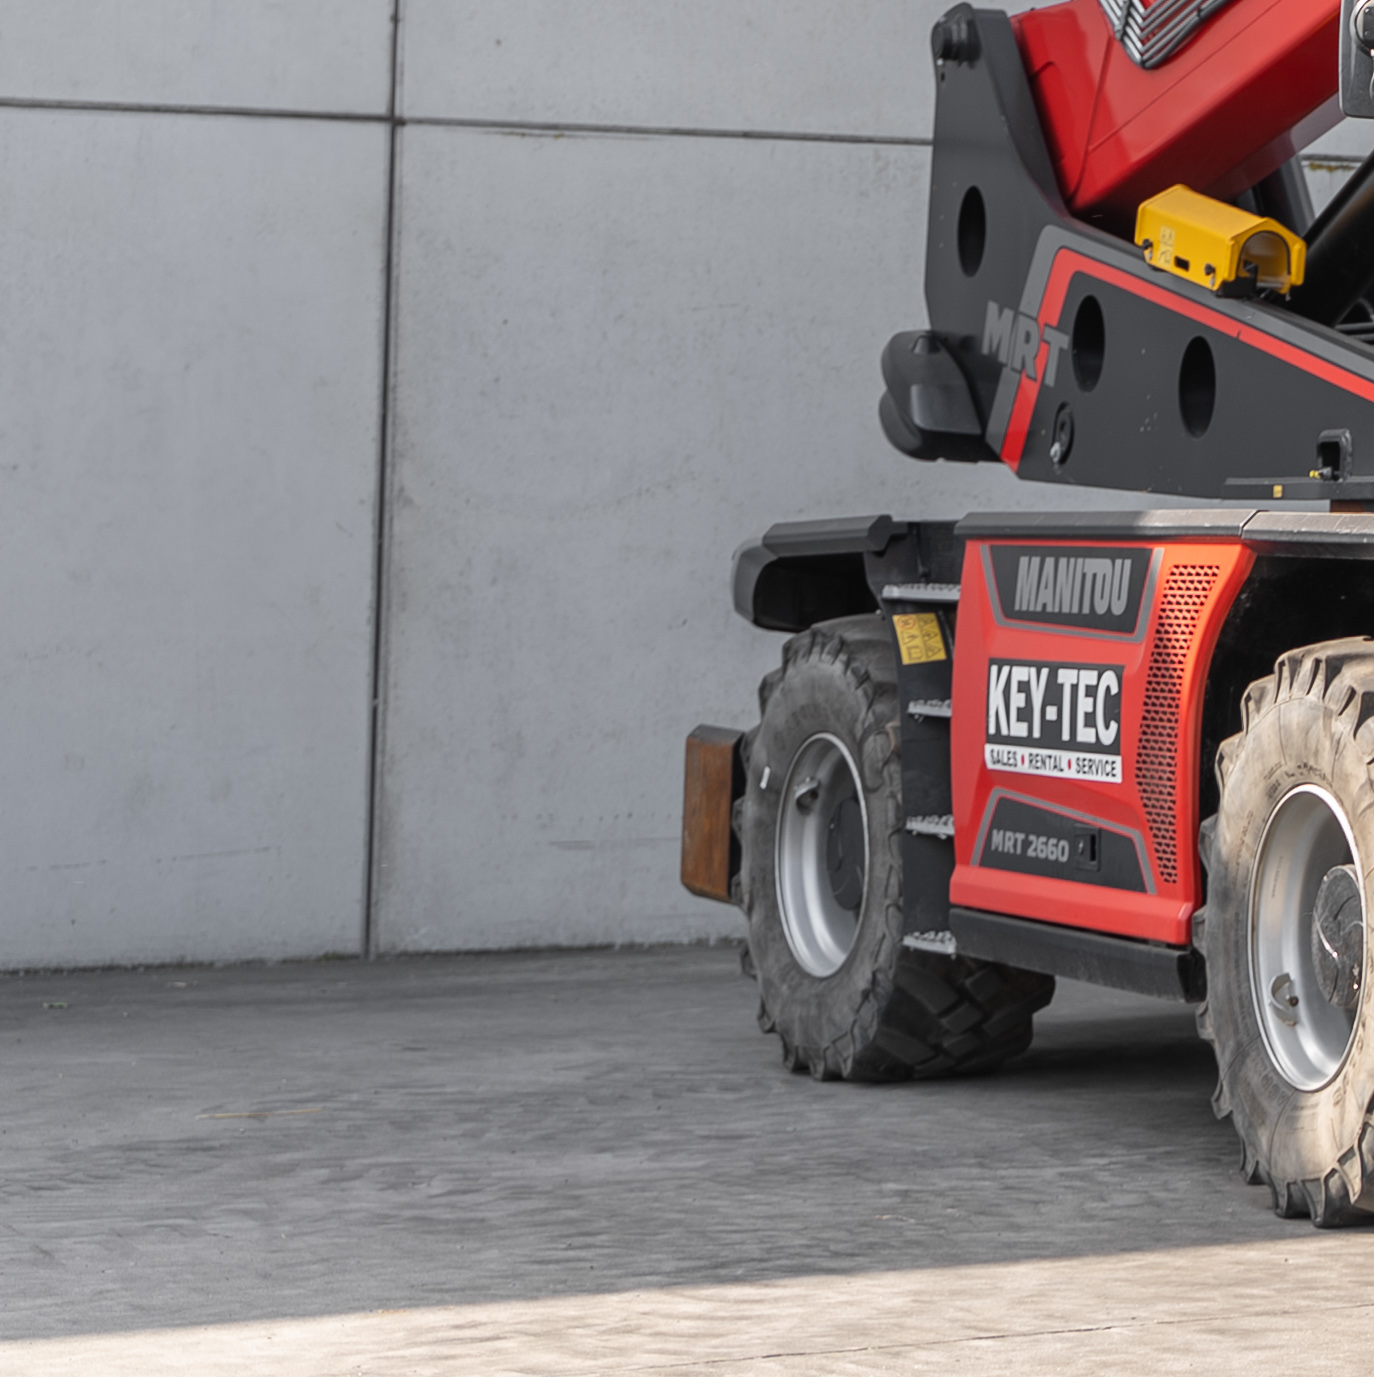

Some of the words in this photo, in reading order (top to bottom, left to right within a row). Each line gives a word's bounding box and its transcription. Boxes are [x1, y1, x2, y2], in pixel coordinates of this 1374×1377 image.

[981, 299, 1070, 388] MRT
[1014, 556, 1132, 616] MANITOU
[988, 664, 1120, 746] KEY-TEC
[990, 749, 1018, 768] SALES
[1029, 752, 1064, 773] RENTAL
[1075, 756, 1117, 778] SERVICE
[991, 828, 1026, 856] MRT
[1027, 834, 1070, 863] 2660
